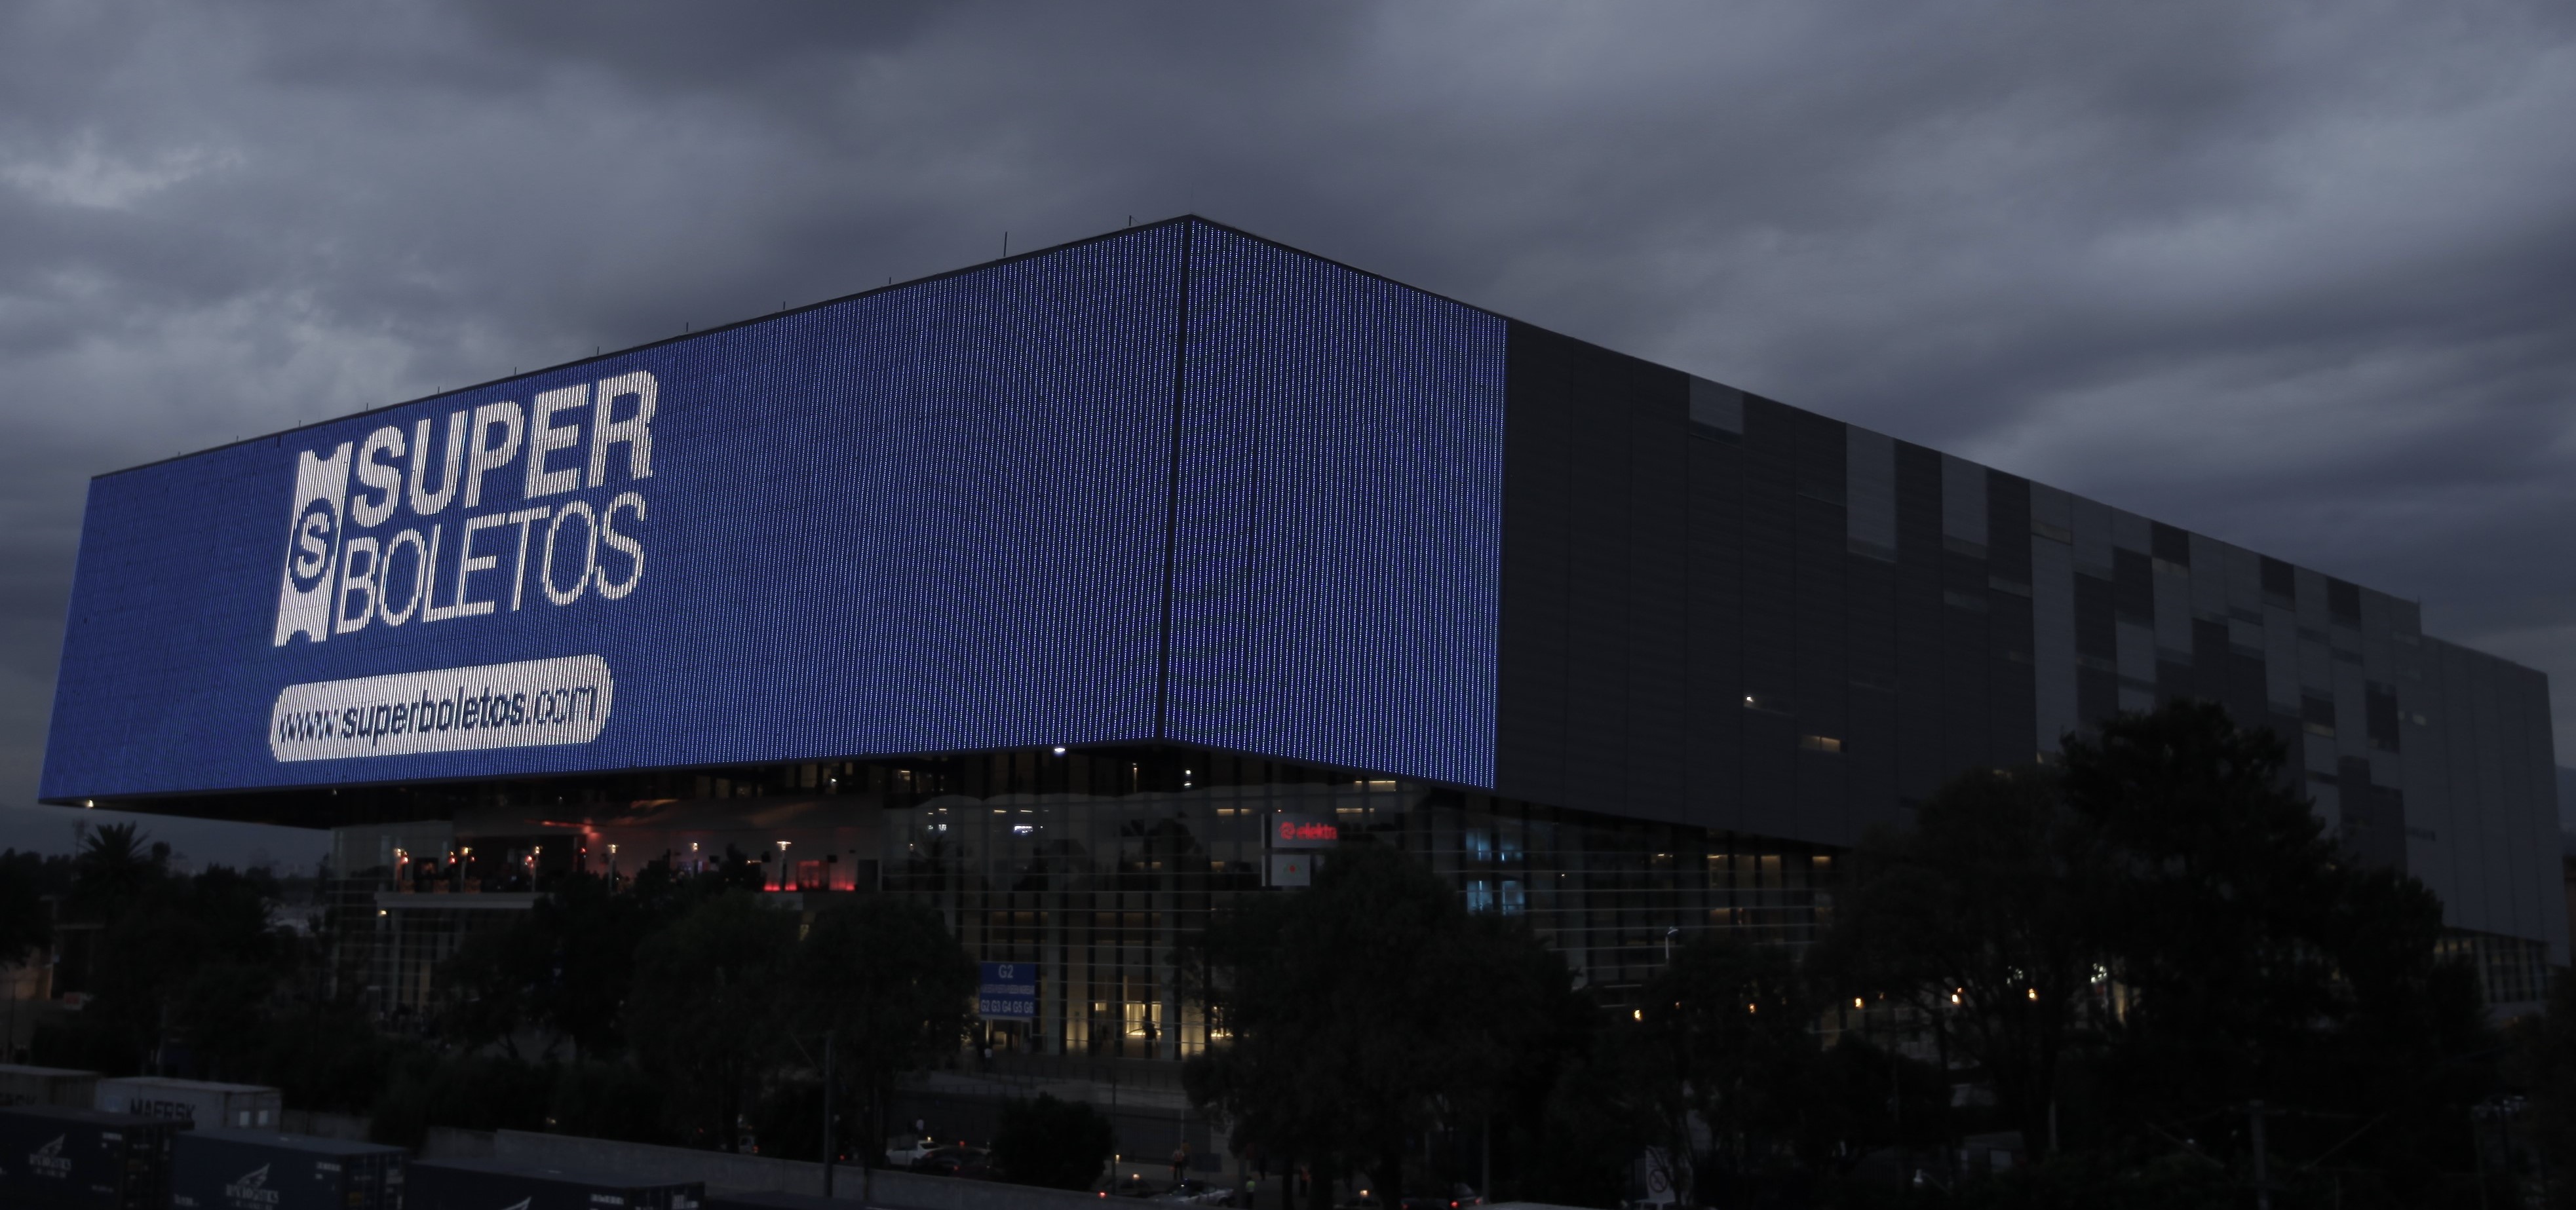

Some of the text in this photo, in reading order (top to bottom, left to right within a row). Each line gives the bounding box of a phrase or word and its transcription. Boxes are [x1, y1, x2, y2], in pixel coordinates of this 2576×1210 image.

[353, 370, 658, 527] SUPER
[296, 512, 330, 578] S
[336, 491, 646, 634] BOLETOS
[280, 687, 596, 746] www.superboletos.com
[998, 964, 1014, 978] G2
[981, 1000, 990, 1012] G2
[991, 1000, 1001, 1012] G3
[1002, 1000, 1012, 1013] G4
